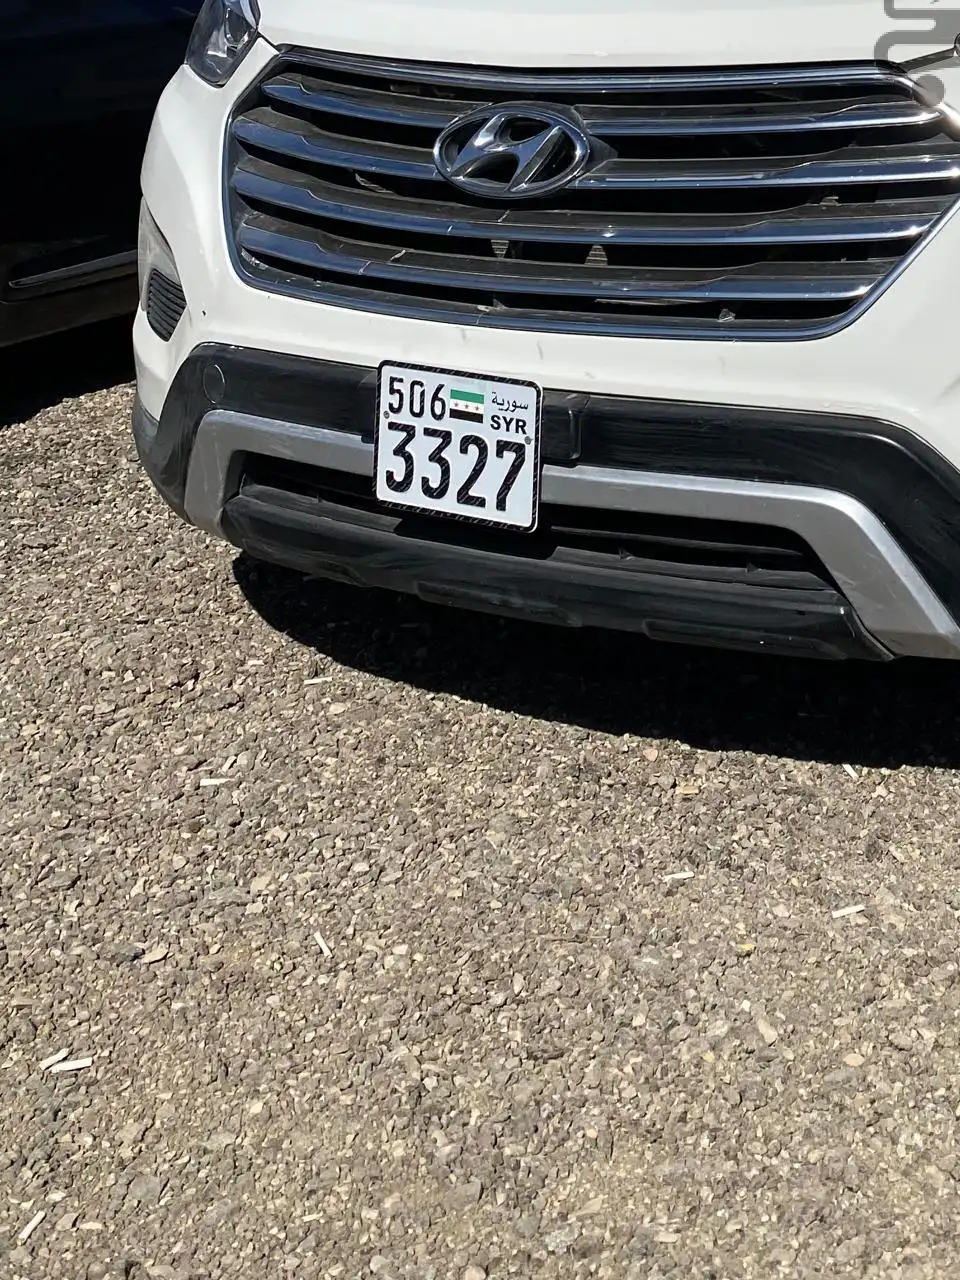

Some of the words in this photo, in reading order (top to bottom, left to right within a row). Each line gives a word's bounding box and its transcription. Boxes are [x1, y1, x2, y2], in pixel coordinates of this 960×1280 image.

[387, 375, 446, 421] 506
[491, 391, 529, 412] سورية
[490, 415, 528, 435] SYR
[385, 421, 526, 512] 3327
